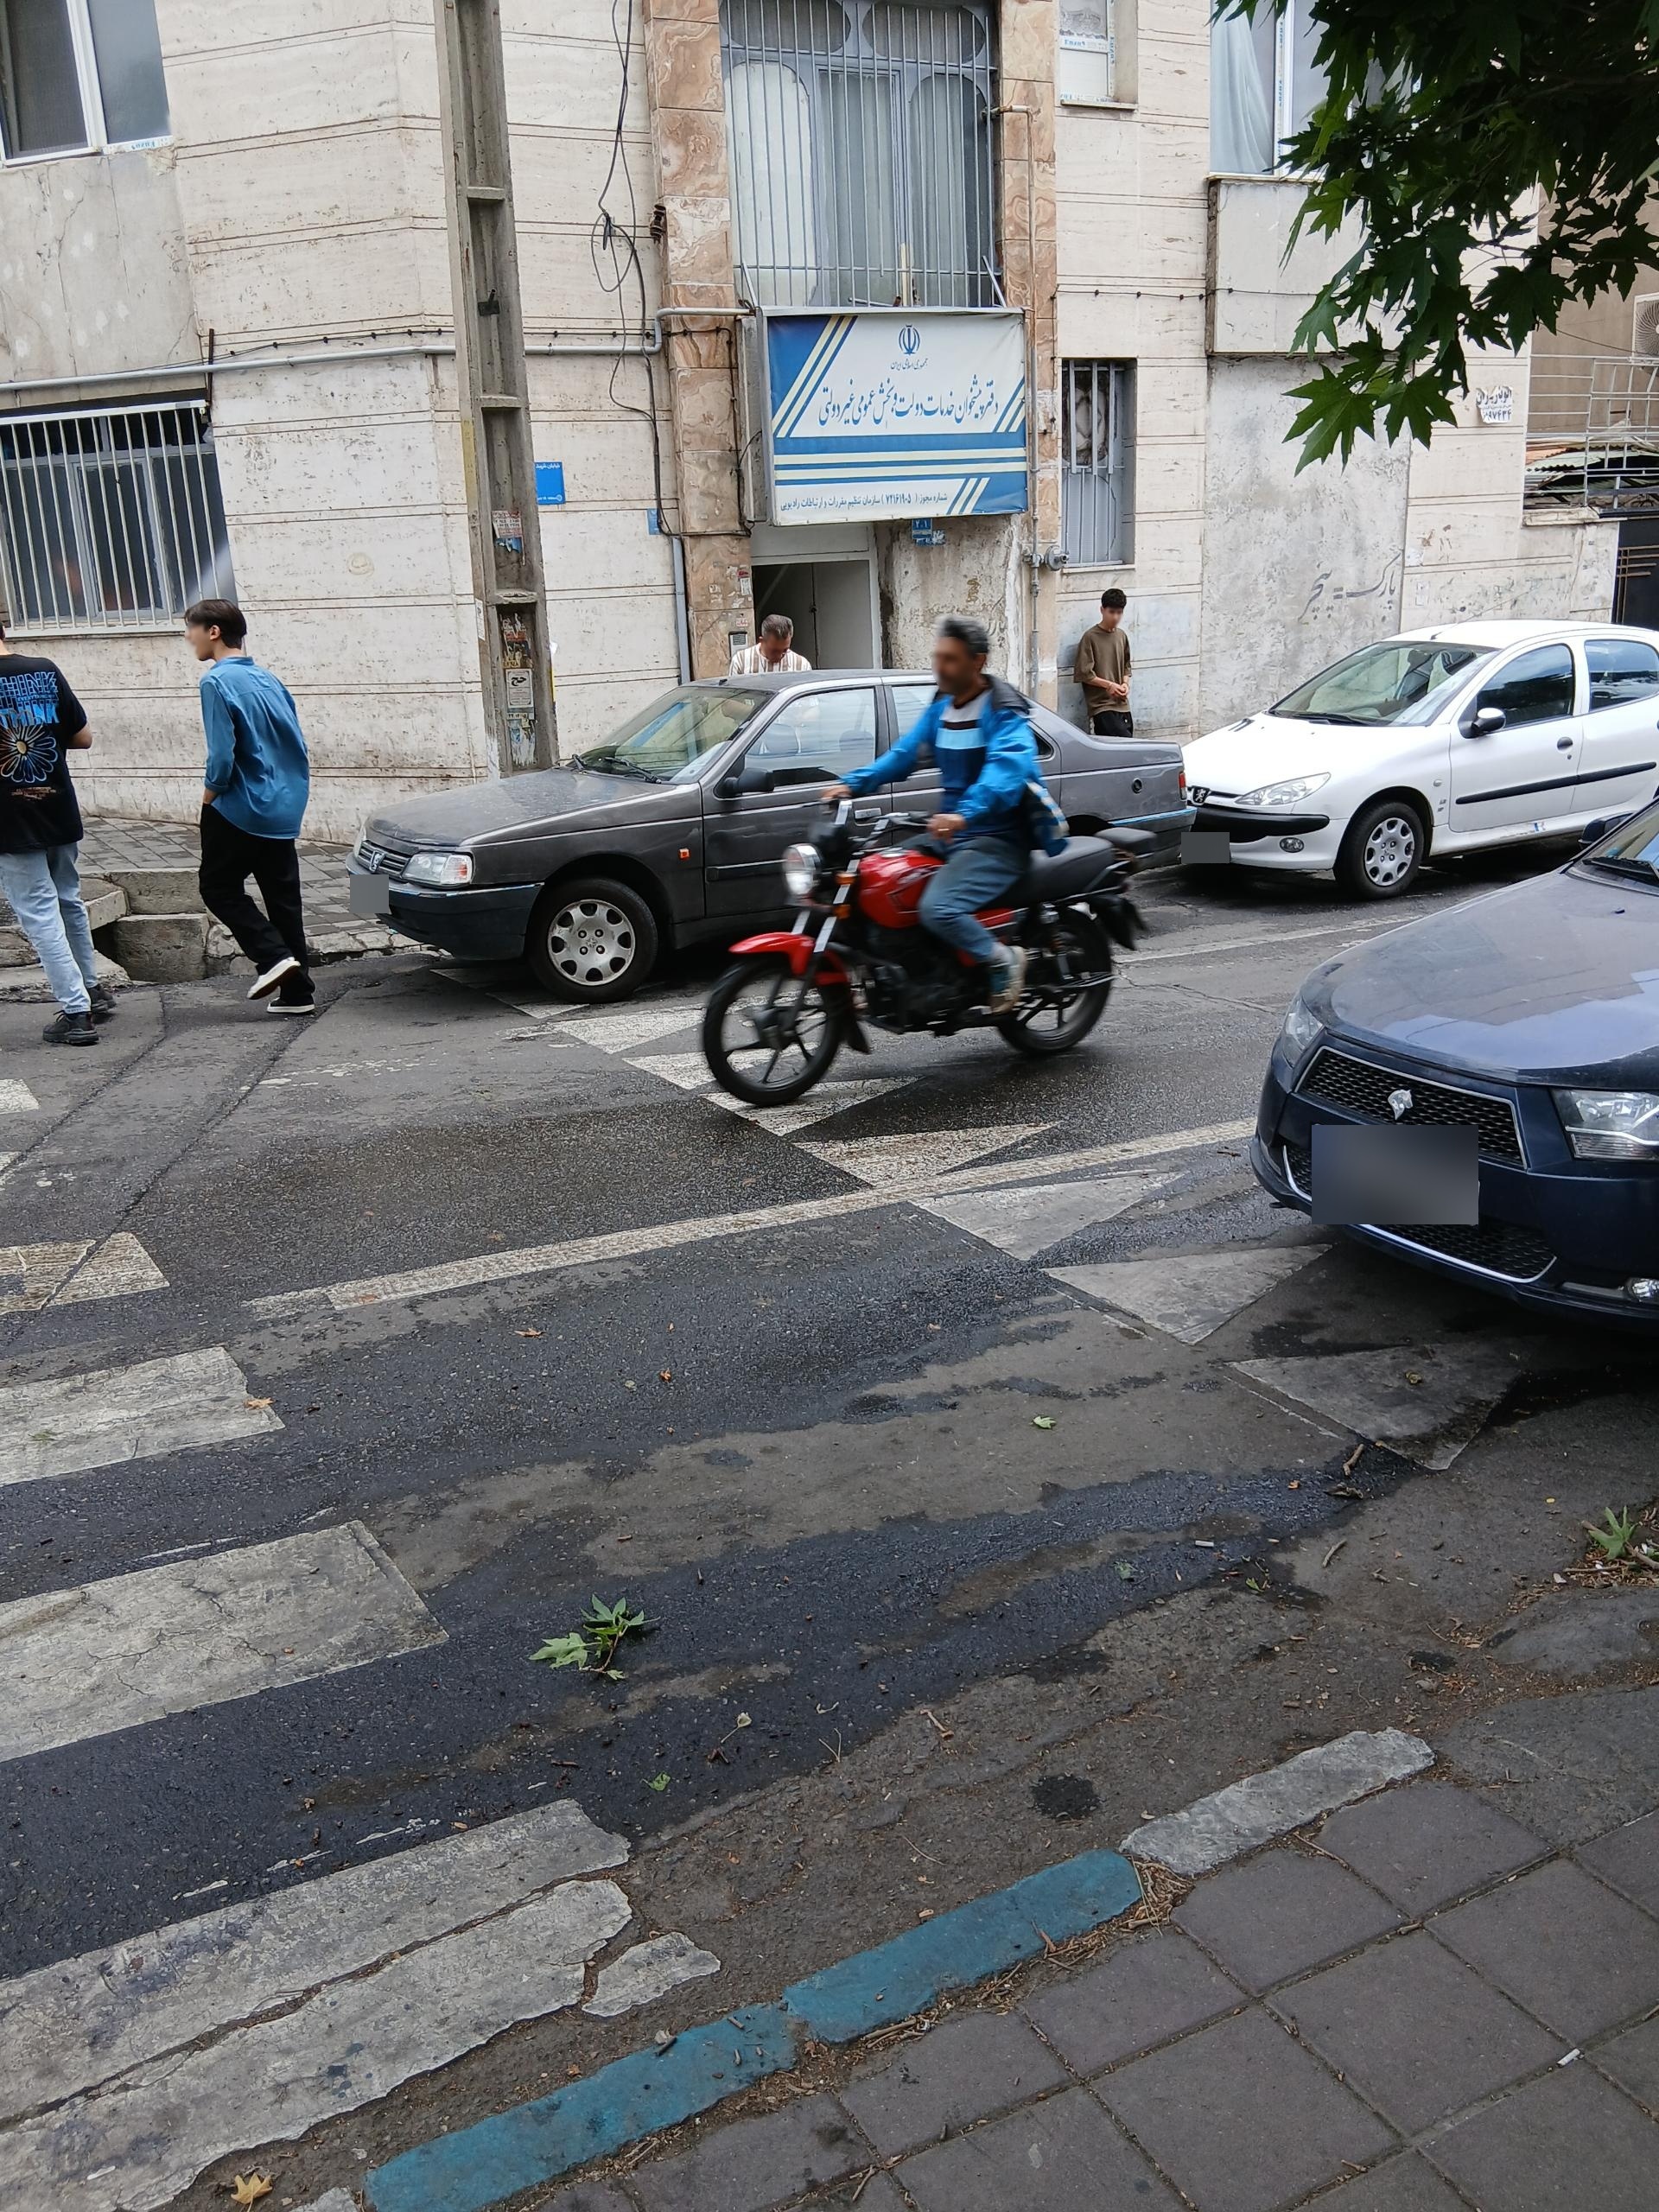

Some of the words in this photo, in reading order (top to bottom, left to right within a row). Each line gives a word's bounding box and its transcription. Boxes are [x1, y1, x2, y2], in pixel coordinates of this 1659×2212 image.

[818, 386, 841, 426] دولتی
[838, 378, 855, 424] غیر
[852, 390, 875, 425] عمومی
[873, 378, 895, 425] بخش
[895, 392, 924, 416] دولت
[924, 391, 955, 416] خدمات
[954, 373, 984, 424] پیشخوان
[980, 379, 998, 421] دفتر
[801, 496, 823, 508] ارتباطات
[829, 495, 847, 508] مقررات
[848, 496, 861, 509] تنظیم
[863, 494, 880, 506] سازمان
[919, 494, 932, 505] مجوز
[933, 492, 948, 504] شماره
[1345, 548, 1402, 622] پارک
